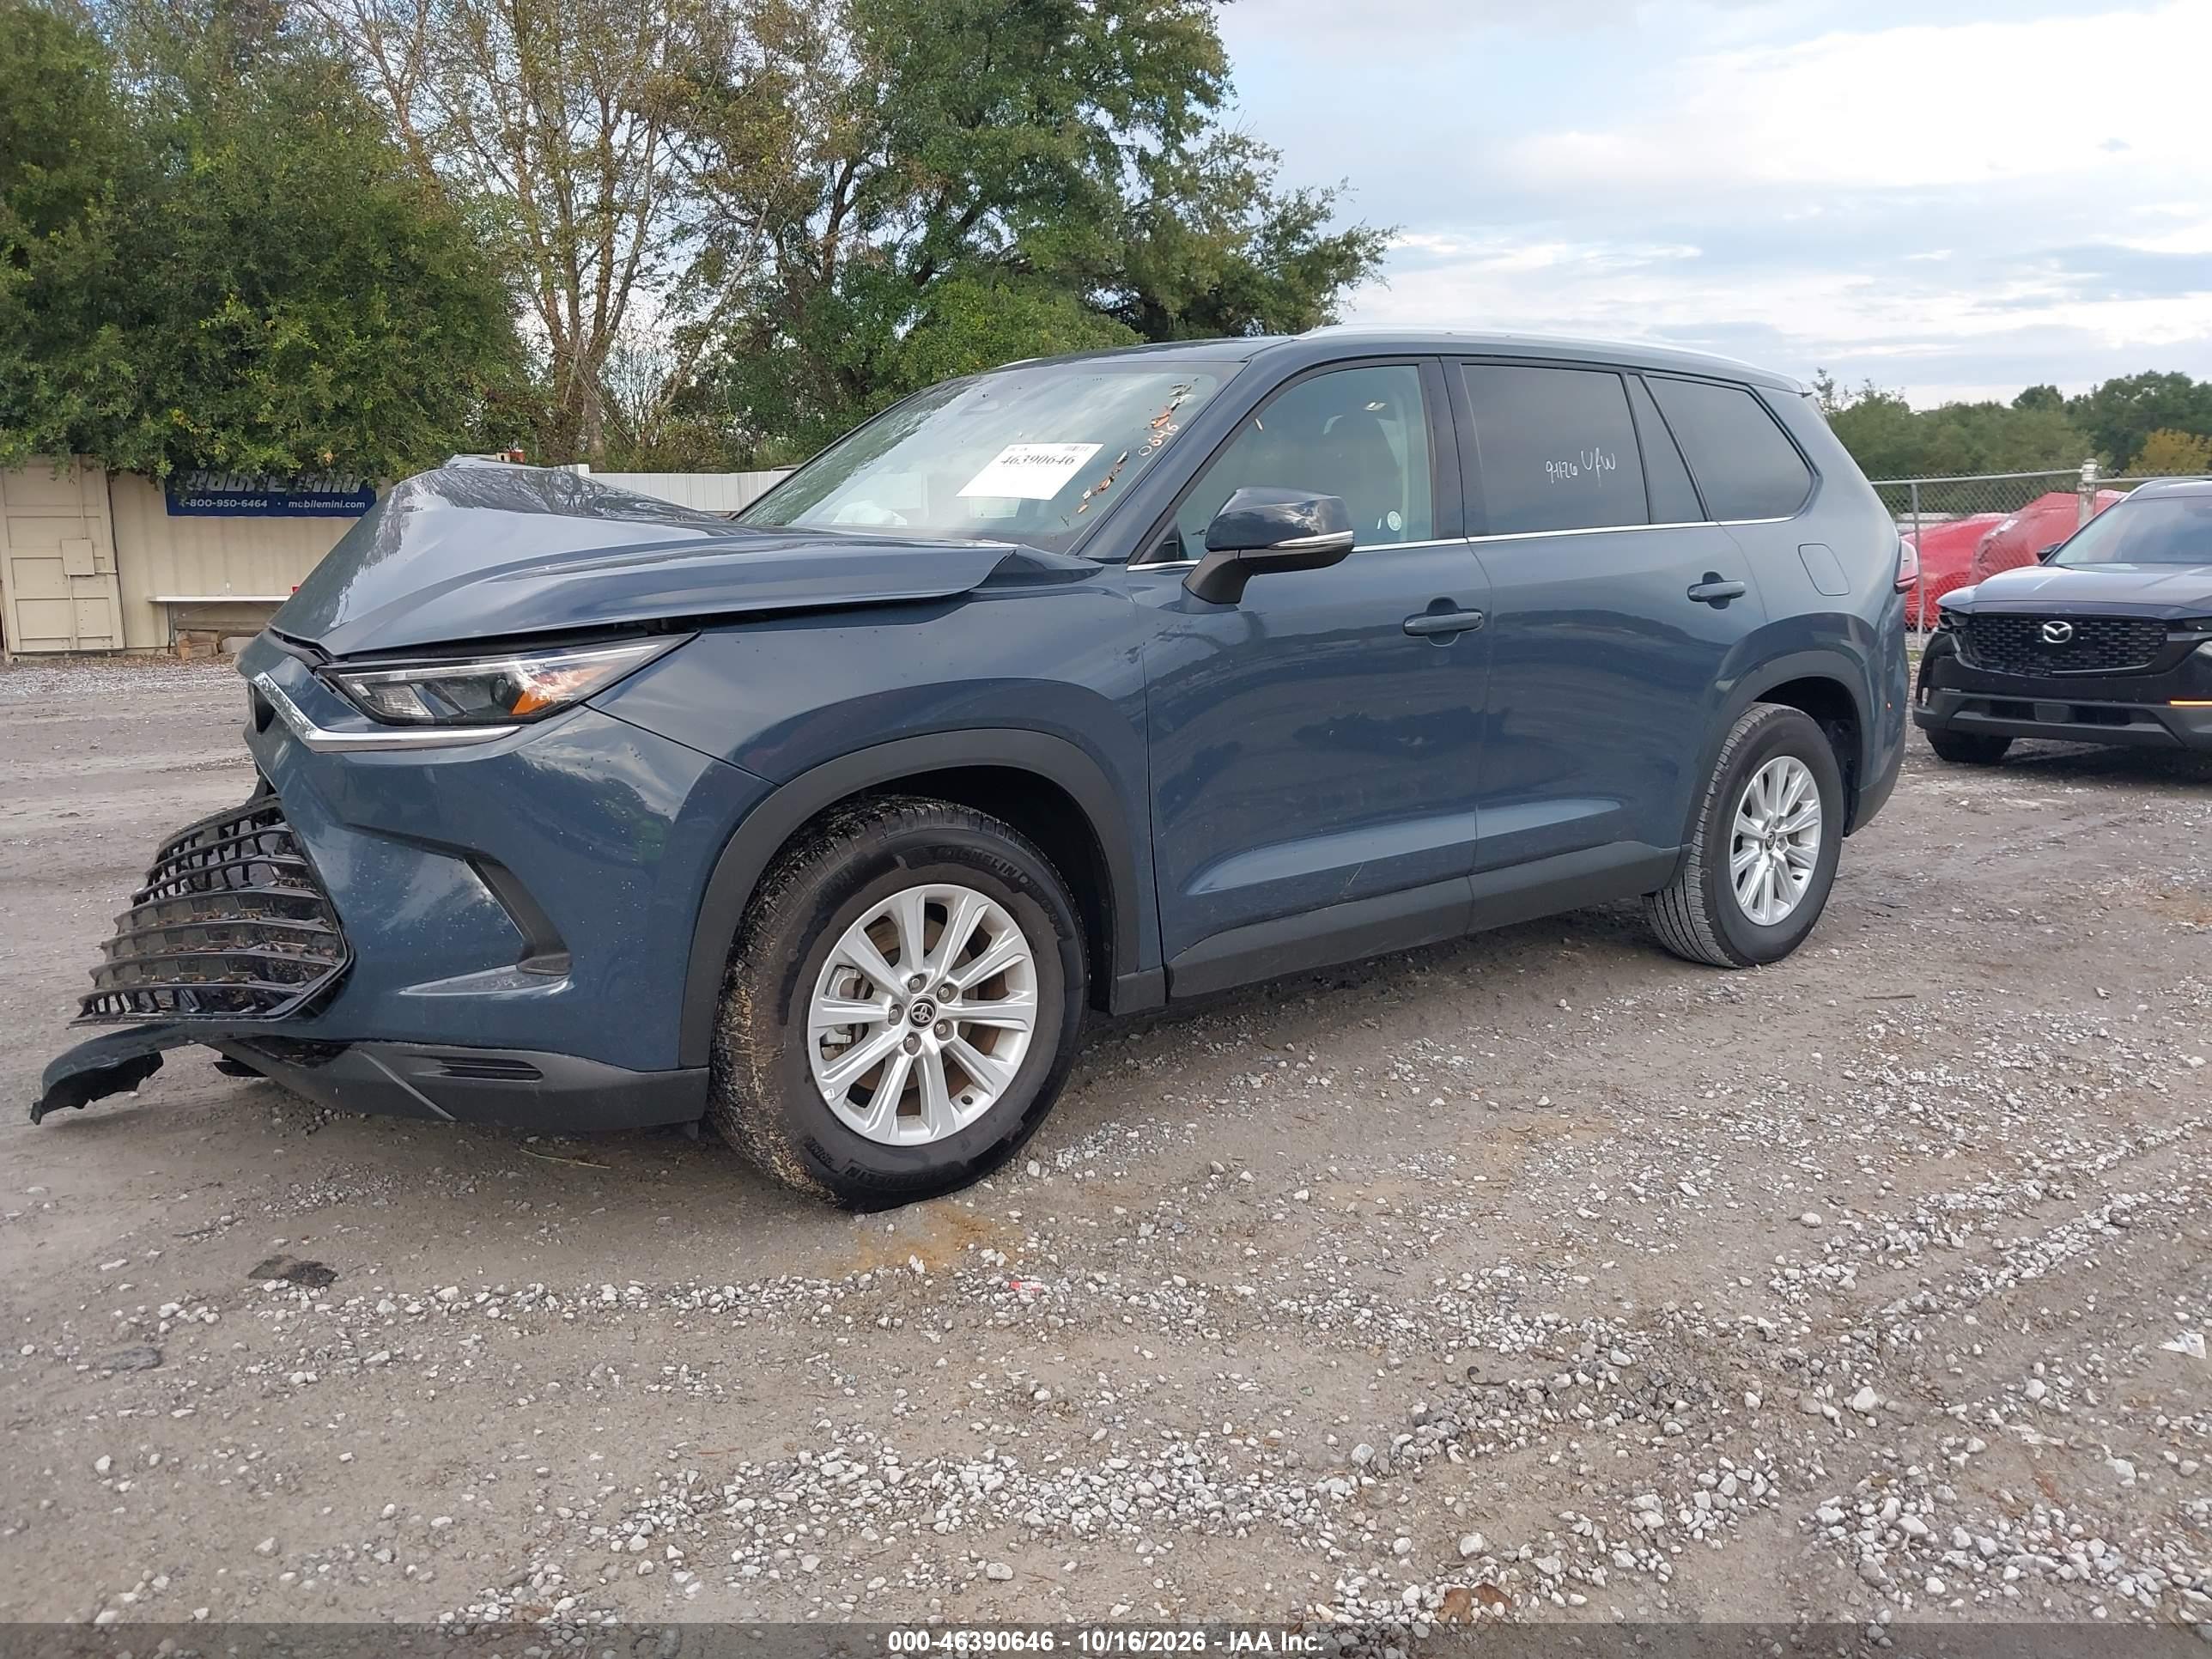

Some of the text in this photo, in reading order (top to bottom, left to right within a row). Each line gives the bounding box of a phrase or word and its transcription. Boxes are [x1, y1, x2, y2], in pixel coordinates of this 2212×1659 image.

[1000, 454, 1079, 465] 46390646
[179, 499, 366, 508] -800-950-6464 mobilemini.com
